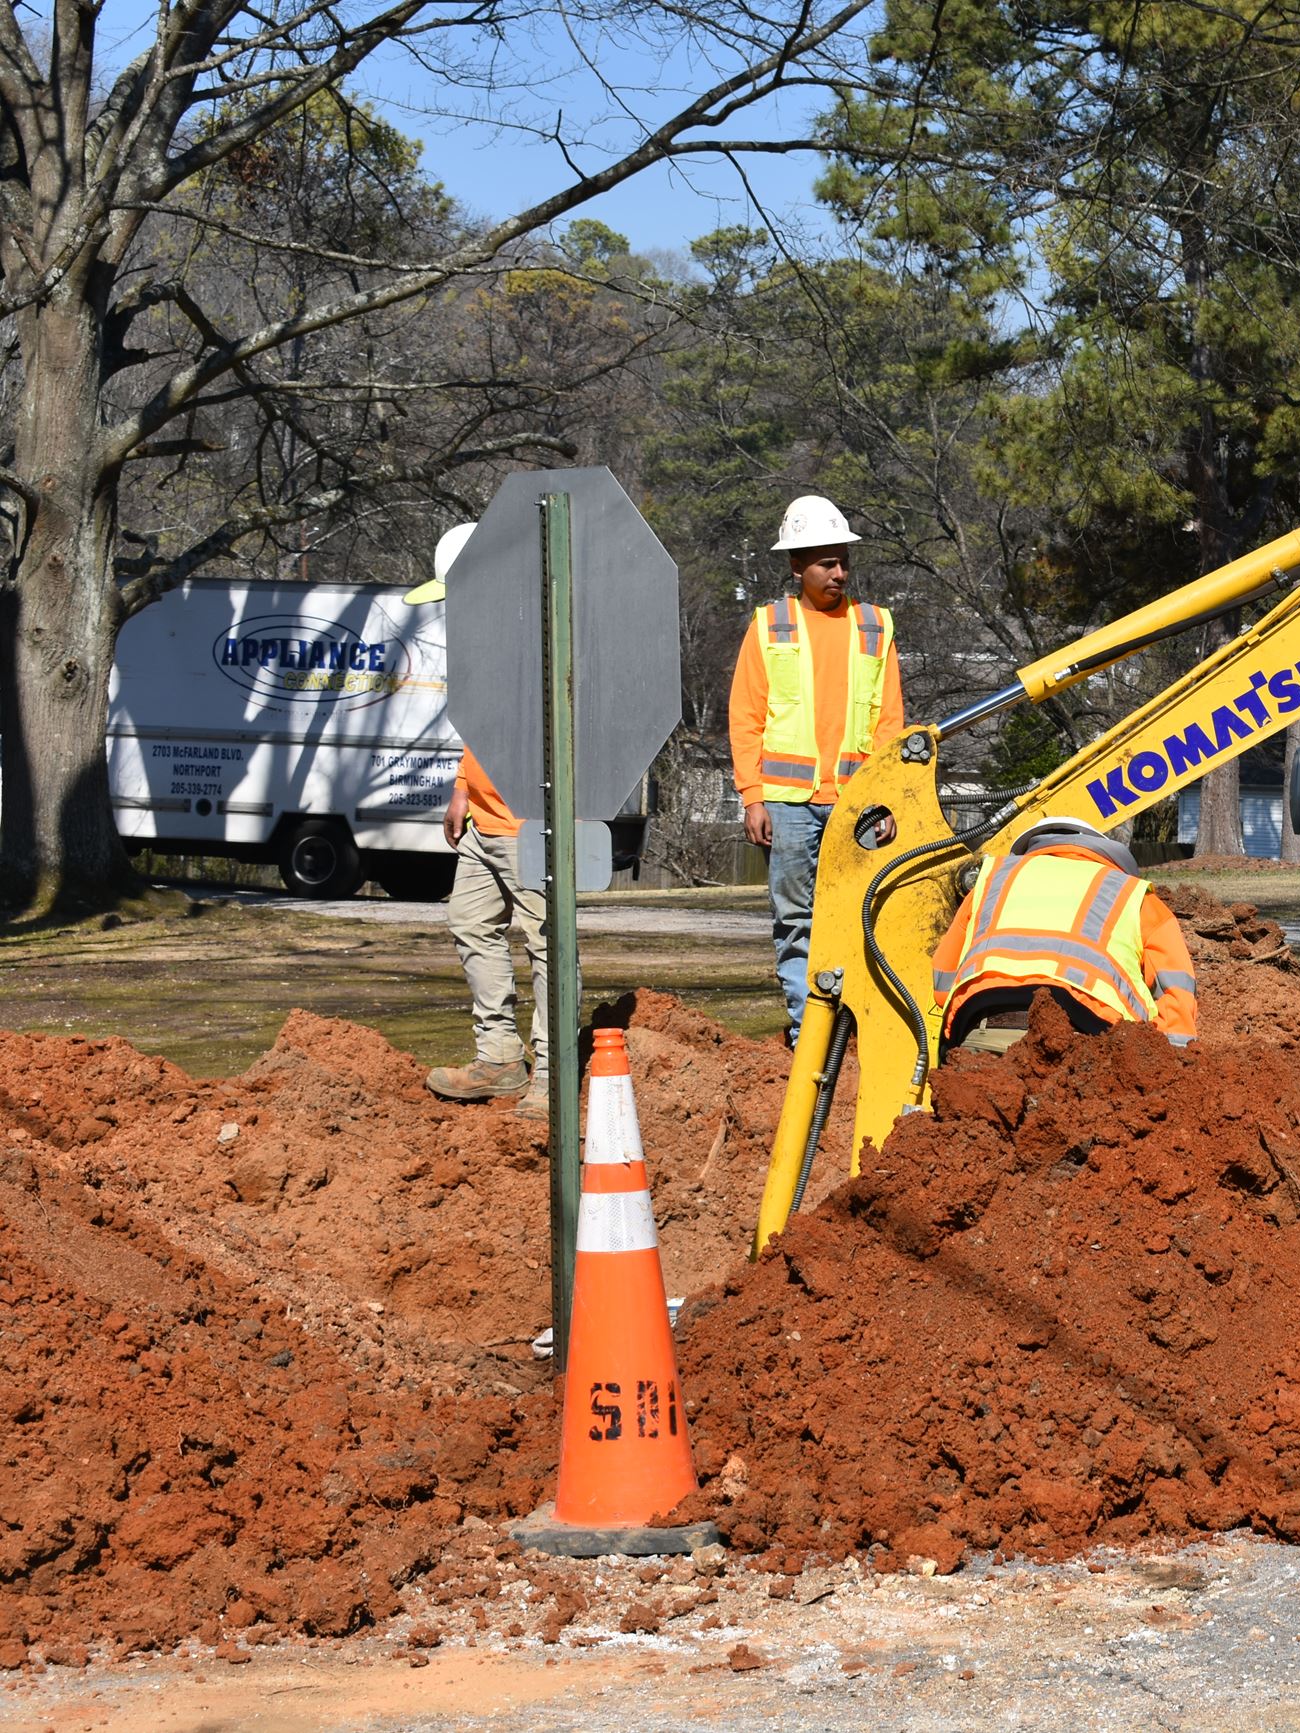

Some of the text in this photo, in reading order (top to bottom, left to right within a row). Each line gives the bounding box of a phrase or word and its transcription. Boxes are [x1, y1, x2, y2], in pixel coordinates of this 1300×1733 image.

[221, 638, 386, 671] APPLIANCE
[283, 671, 399, 694] CONNECTION
[152, 745, 244, 761] 2703 McFARLAND BLVD.
[371, 755, 386, 767] 701
[388, 756, 434, 769] GRAYMONT
[436, 758, 455, 770] AVE.
[173, 764, 222, 778] NORTHPORT
[171, 781, 222, 796] 205-339-2774
[389, 774, 444, 788] BIRMINGHAM
